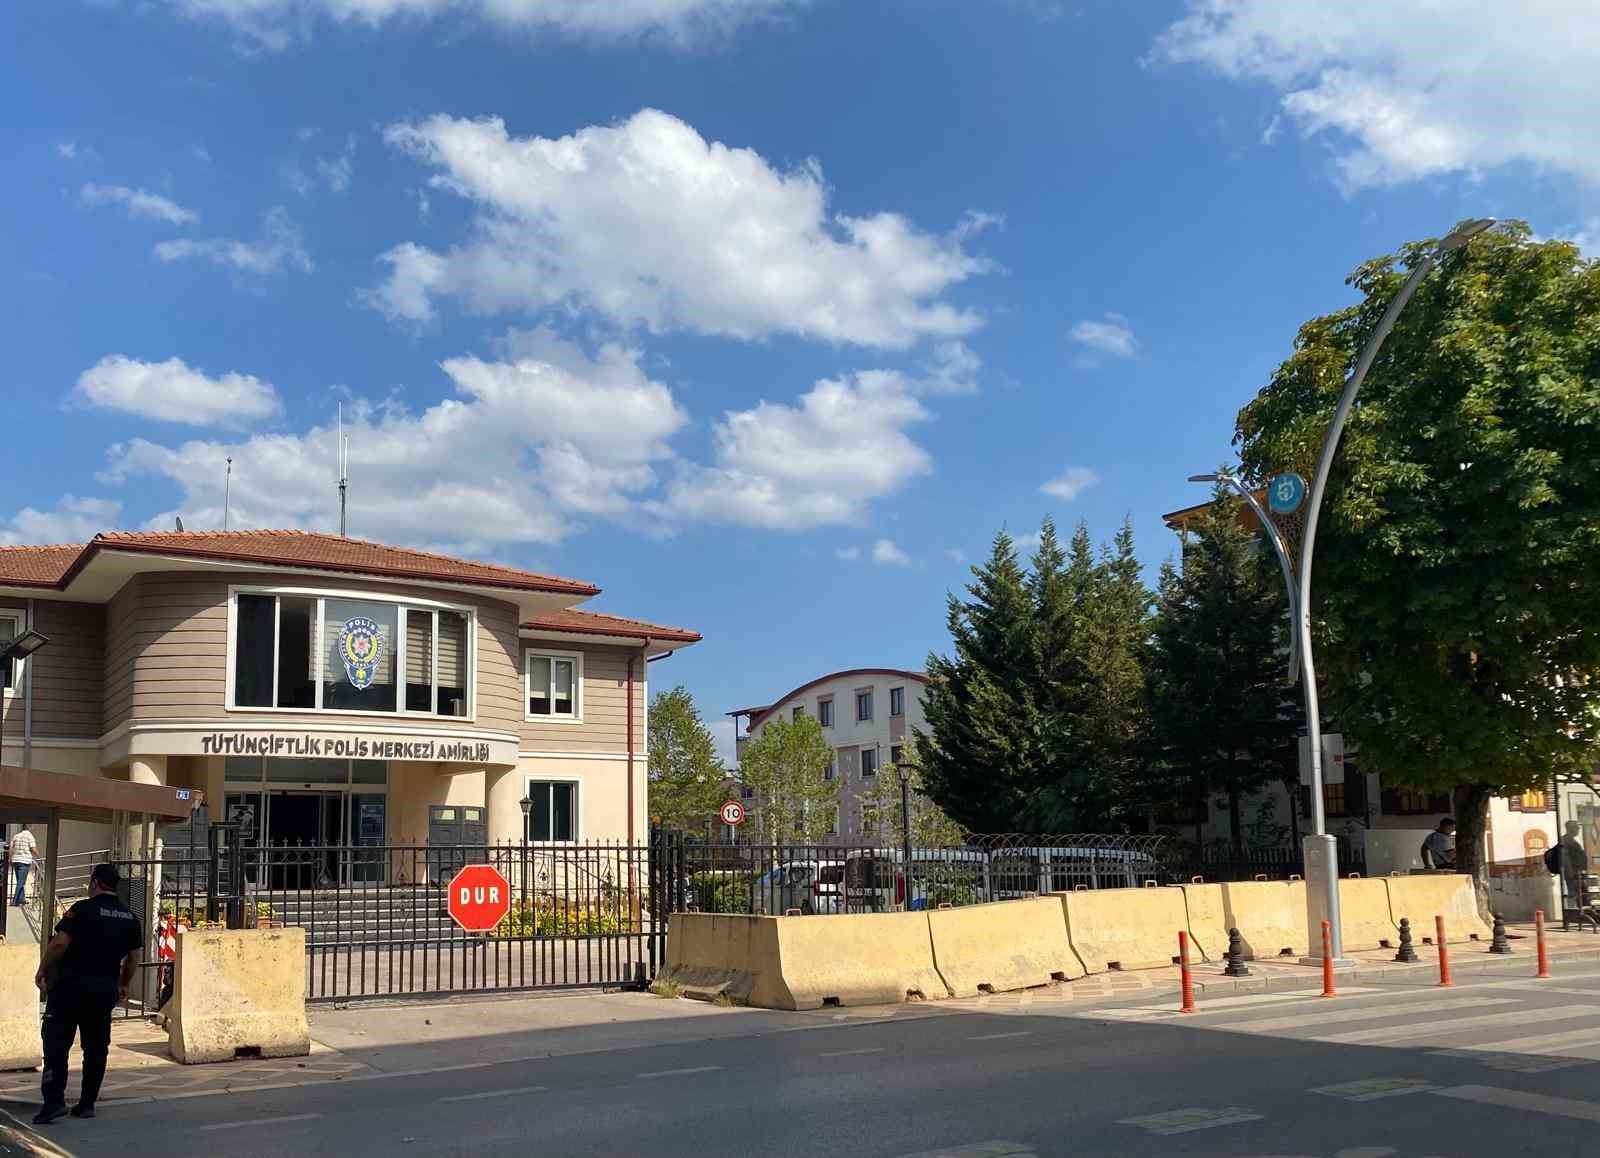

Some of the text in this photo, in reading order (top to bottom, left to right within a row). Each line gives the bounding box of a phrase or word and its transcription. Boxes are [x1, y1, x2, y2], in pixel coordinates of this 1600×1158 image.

[324, 736, 369, 756] POLİS
[371, 740, 434, 760] MERKEZİ
[437, 741, 490, 762] AMİRLİĞİ
[726, 808, 740, 819] 10
[460, 886, 500, 905] DUR
